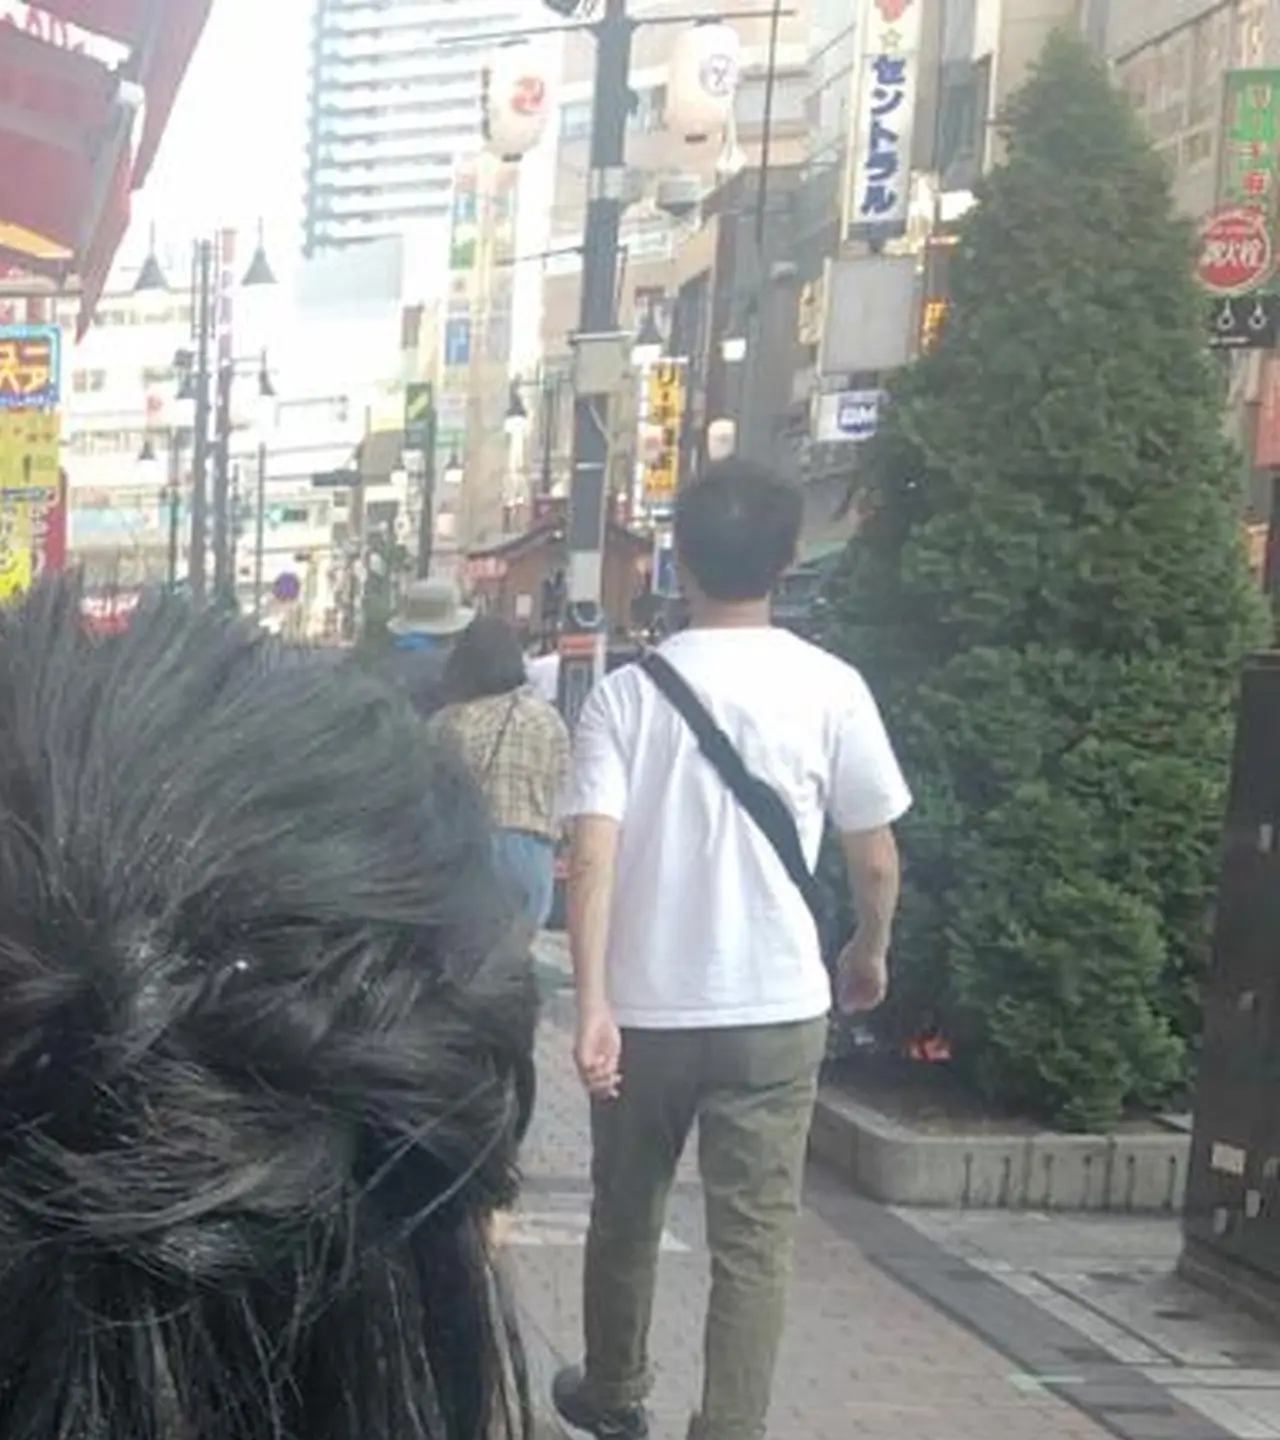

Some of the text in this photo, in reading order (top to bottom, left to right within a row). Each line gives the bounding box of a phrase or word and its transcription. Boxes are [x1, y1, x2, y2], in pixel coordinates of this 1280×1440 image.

[861, 54, 906, 215] セントラル
